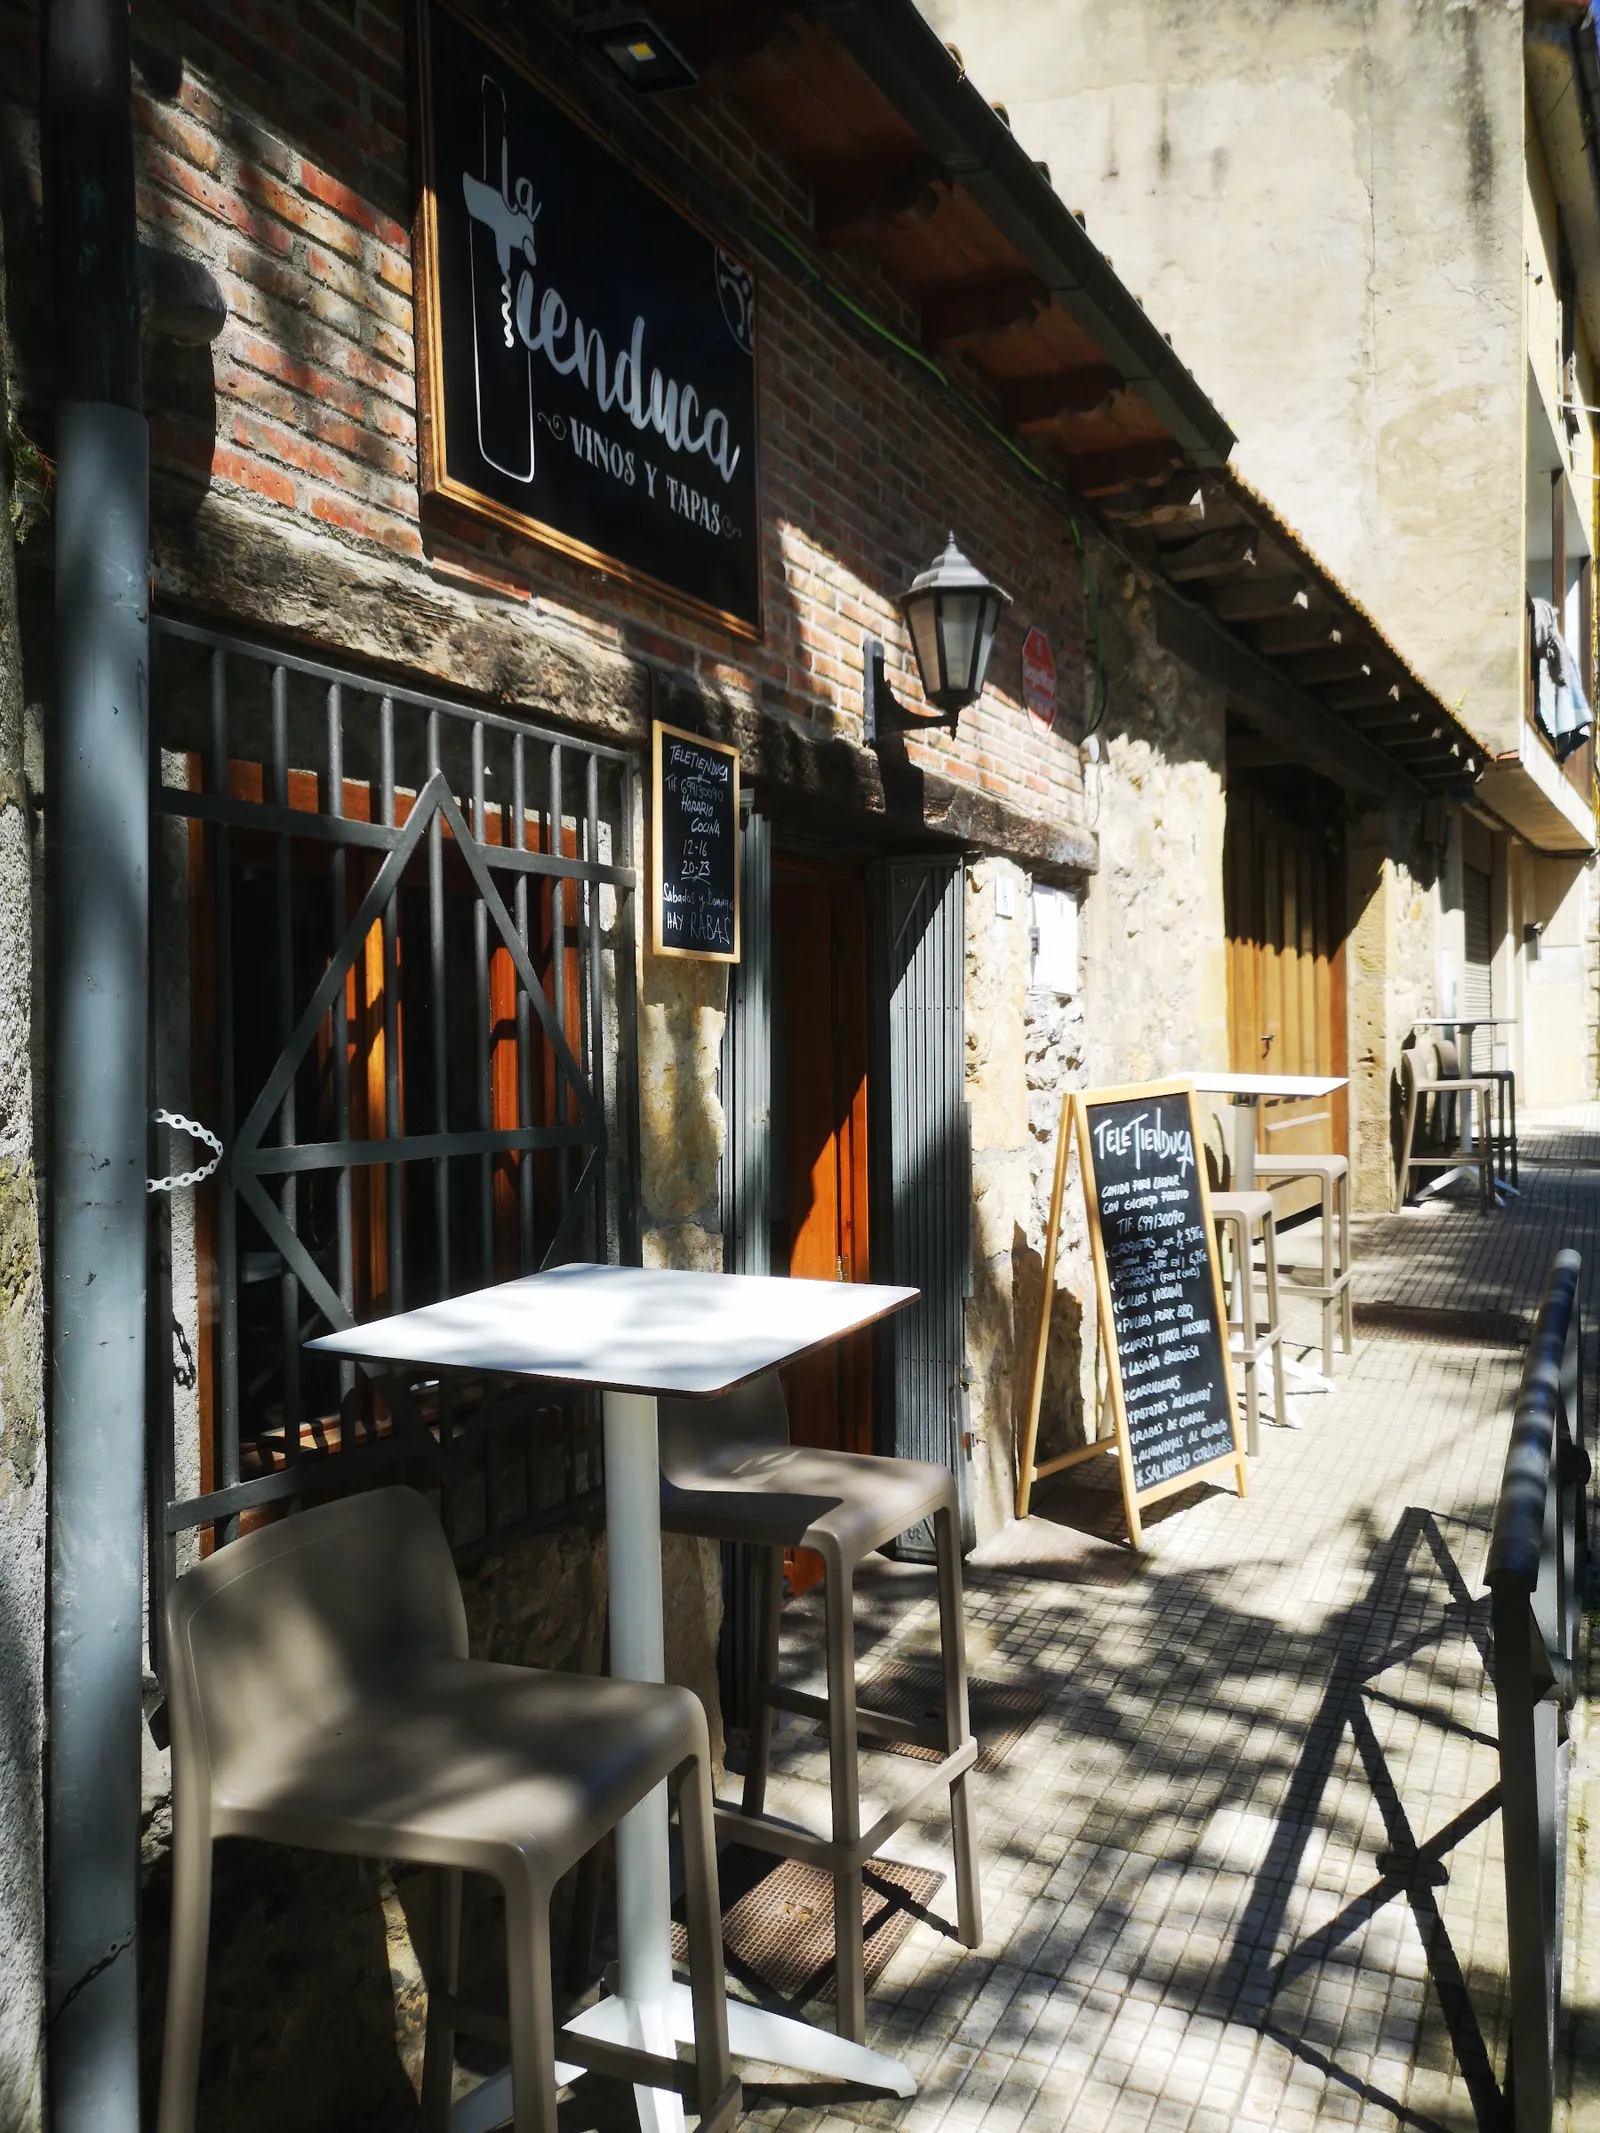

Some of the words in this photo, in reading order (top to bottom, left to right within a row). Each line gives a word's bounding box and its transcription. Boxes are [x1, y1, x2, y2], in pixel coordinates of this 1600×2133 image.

[501, 136, 541, 222] la
[569, 416, 636, 486] VINOS
[644, 460, 658, 498] Y
[666, 474, 722, 535] TAPAS
[680, 779, 724, 801] 699130090
[681, 795, 714, 817] HORARIO
[691, 817, 720, 837] COCINA
[681, 860, 710, 876] 20-23
[698, 895, 705, 913] y
[666, 910, 684, 931] HAY
[690, 911, 732, 945] RABAS
[1101, 1182, 1130, 1198] COMIDA
[1132, 1178, 1151, 1192] PARA
[1153, 1174, 1181, 1190] LLEVAR
[1103, 1200, 1119, 1215] CON
[1137, 1209, 1186, 1232] 699130090
[1154, 1308, 1176, 1323] PORK
[1177, 1304, 1194, 1320] BBQ
[1123, 1335, 1154, 1354] CURRY
[1135, 1422, 1163, 1444] RABAS
[1167, 1418, 1177, 1431] DE
[1187, 1430, 1199, 1444] AL
